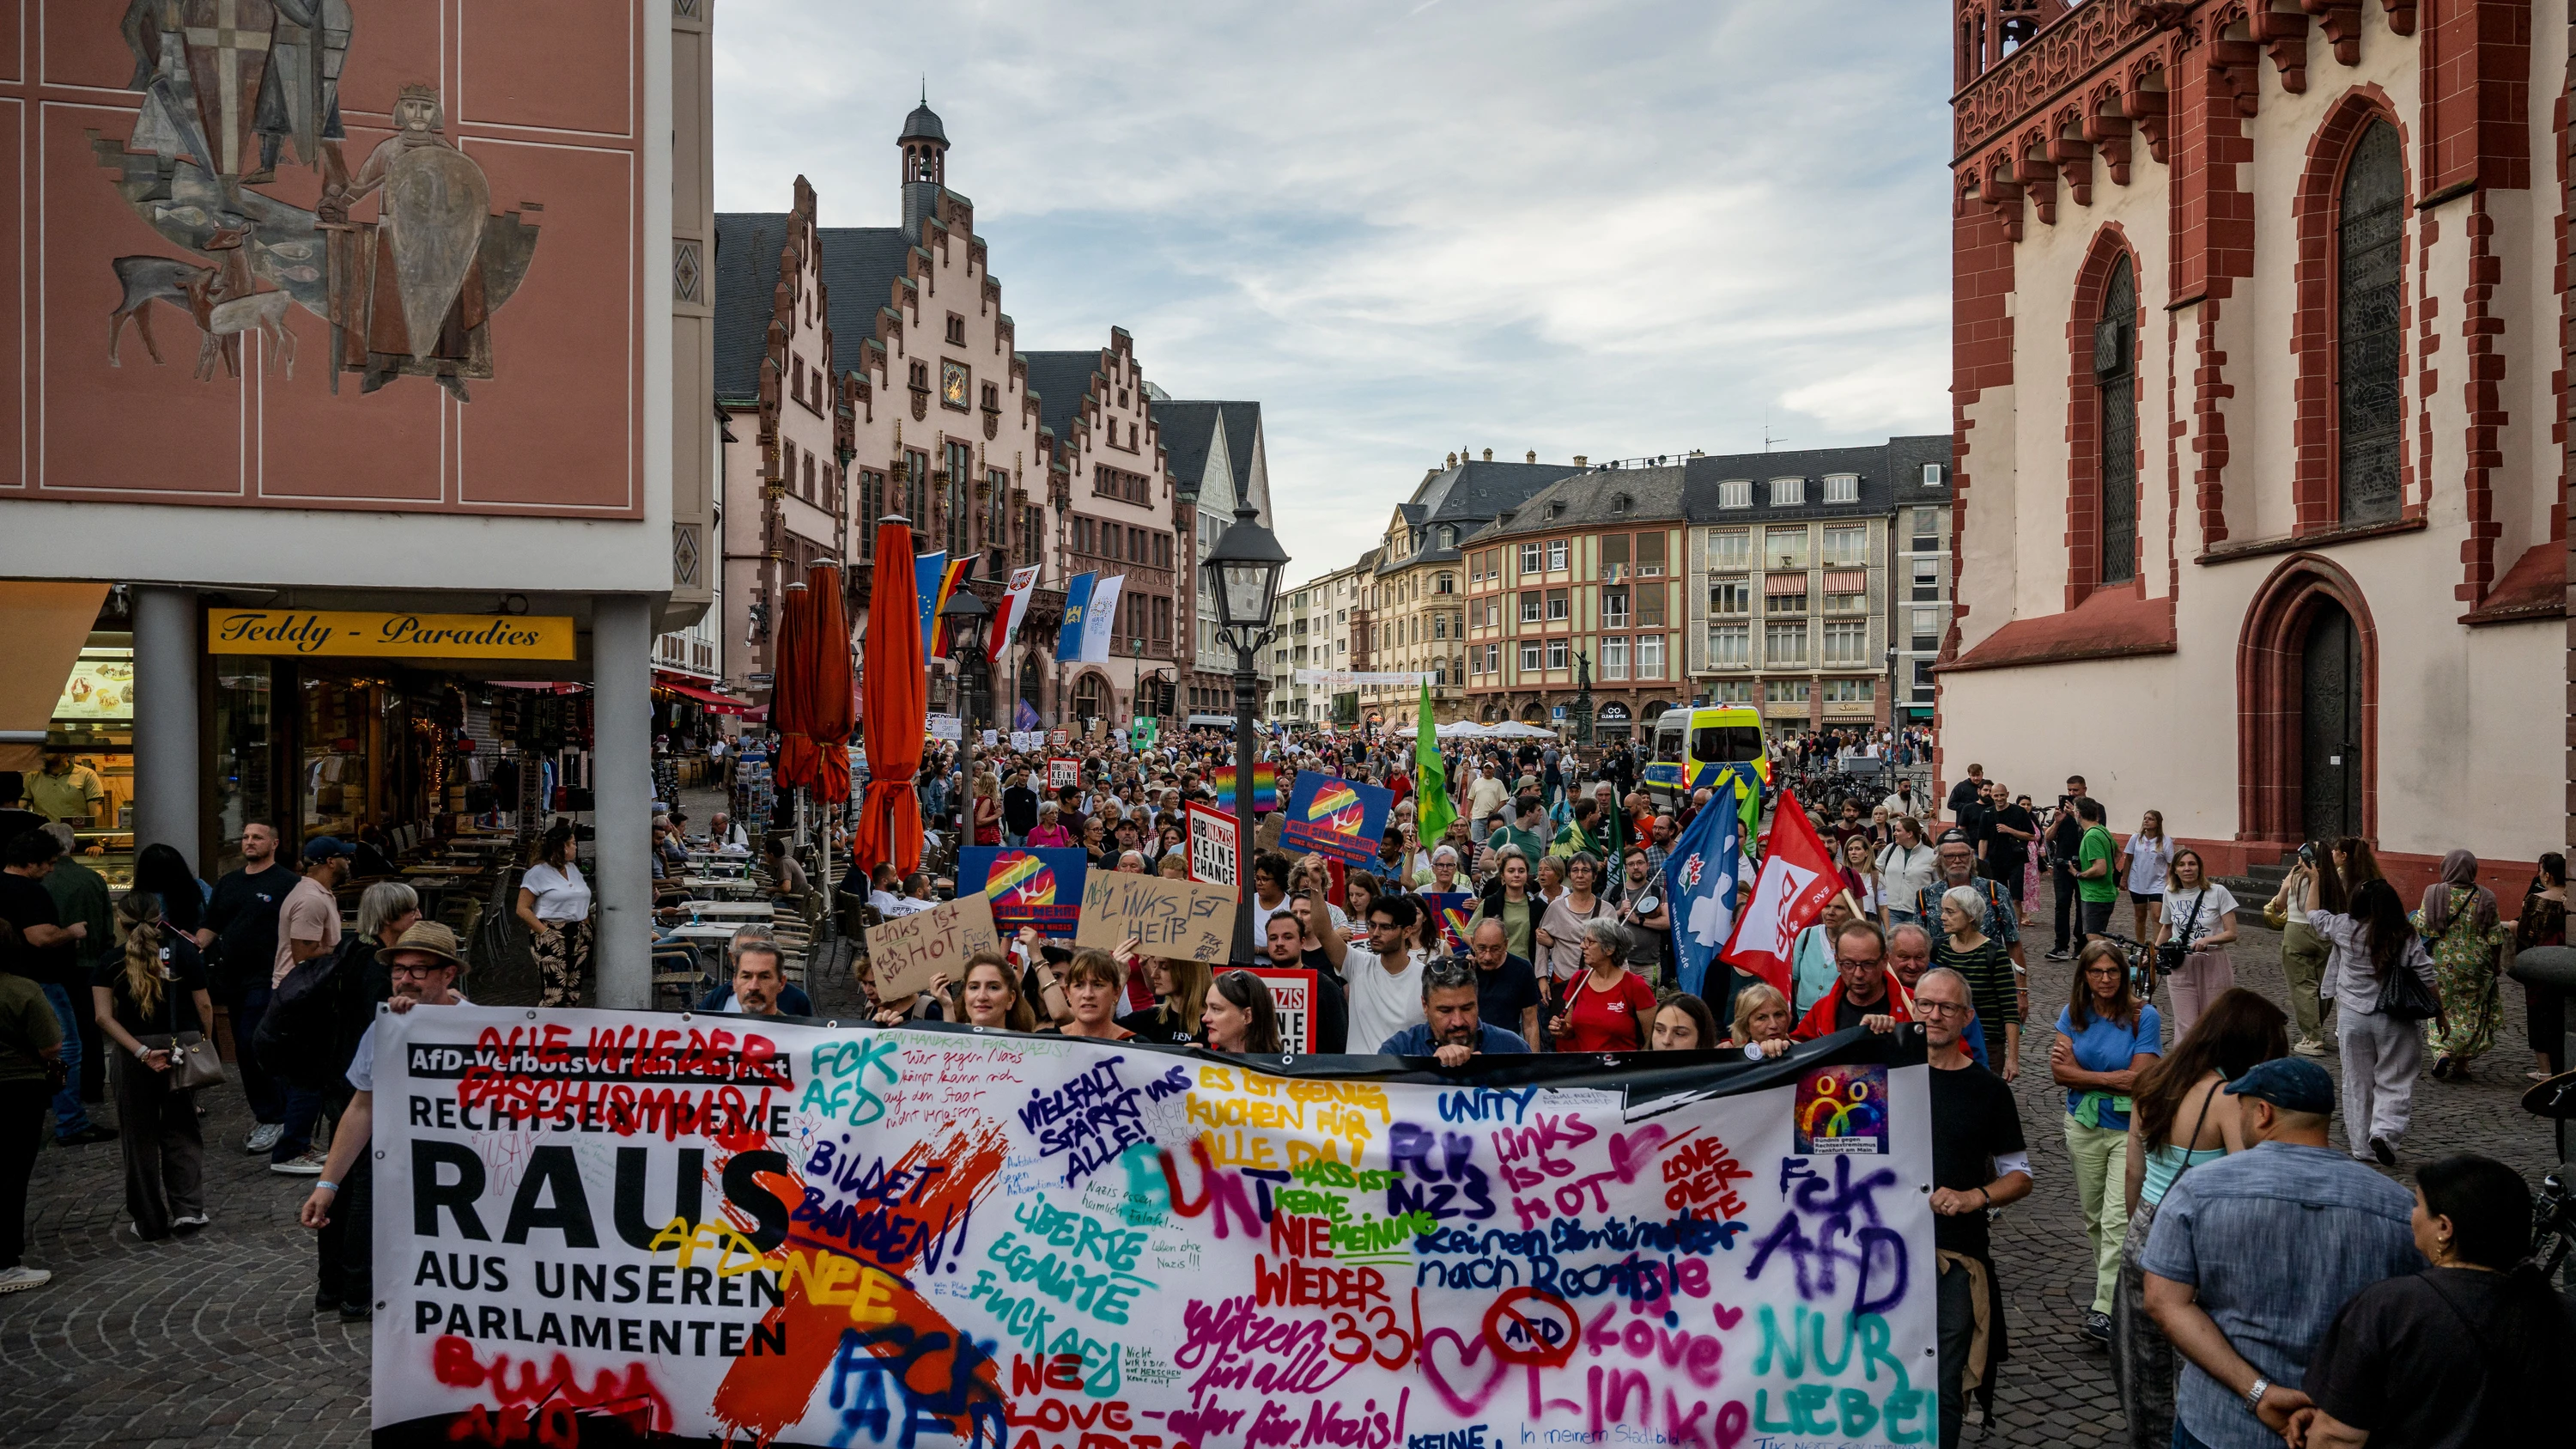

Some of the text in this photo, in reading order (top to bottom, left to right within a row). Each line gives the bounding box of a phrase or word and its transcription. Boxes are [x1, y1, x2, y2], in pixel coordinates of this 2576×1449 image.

[221, 614, 335, 652] Teddy
[378, 617, 543, 646] Paradies
[1552, 707, 1563, 718] U
[1051, 770, 1077, 779] KEINE
[1193, 818, 1234, 849] GIB NAZIS
[1289, 837, 1367, 862] GANZ KLAR GEGEN NAZIS
[1290, 823, 1308, 834] WIR
[1312, 827, 1337, 841] SIND
[1339, 834, 1374, 851] MEHR!
[1193, 837, 1235, 869] KEINE
[1194, 856, 1235, 886] CHANCE
[1033, 905, 1076, 917] MEHR!
[908, 925, 959, 966] HOT
[1671, 902, 1690, 970] naturfreunde.de
[876, 947, 898, 971] FCK
[882, 953, 908, 984] NZS
[1271, 988, 1304, 1009] AZIS
[875, 1030, 907, 1046] KEIN
[477, 1024, 795, 1093] NIE WIEDER
[811, 1037, 899, 1087] FCK
[902, 1050, 938, 1065] Wer
[943, 1051, 984, 1071] gegen
[456, 1065, 772, 1151] FASCHISMUS!
[884, 1090, 907, 1115] auf
[940, 1087, 987, 1104] Staat
[1199, 1067, 1234, 1092] ES
[1285, 1078, 1391, 1123] GENUG
[410, 1094, 791, 1138] RECHTSEXTREME
[1039, 1087, 1142, 1160] STÄRKT
[1185, 1093, 1373, 1141] KUCHEN FÜR
[1065, 1118, 1157, 1188] ALLE!
[1288, 1137, 1365, 1184] DA!
[1388, 1121, 1473, 1184] FCK
[1662, 1135, 1730, 1184] LOVE
[1120, 1137, 1292, 1240] BUNT
[1293, 1158, 1357, 1189] HASS
[1664, 1158, 1754, 1211] OVER
[410, 1137, 790, 1254] RAUS
[1085, 1179, 1153, 1207] Nazis essen
[1275, 1185, 1353, 1222] KEINE
[1511, 1171, 1619, 1231] HOT
[1180, 1239, 1202, 1253] ohne
[1268, 1208, 1334, 1258] NIE
[414, 1250, 786, 1308] AUS UNSEREN
[1416, 1258, 1521, 1289] nach
[414, 1300, 787, 1358] PARLAMENTEN
[1505, 1317, 1564, 1345] AFD
[1751, 1303, 1910, 1391] NUR
[829, 1324, 999, 1416] FCK
[1125, 1359, 1140, 1367] WIR
[1127, 1345, 1152, 1359] Nicht
[1251, 1341, 1364, 1396] alle
[1012, 1352, 1084, 1397] WE
[1140, 1367, 1182, 1376] MENSCHEN
[1004, 1397, 1133, 1433] LOVE
[1299, 1385, 1411, 1449] Nazis!
[1521, 1422, 1535, 1445] In
